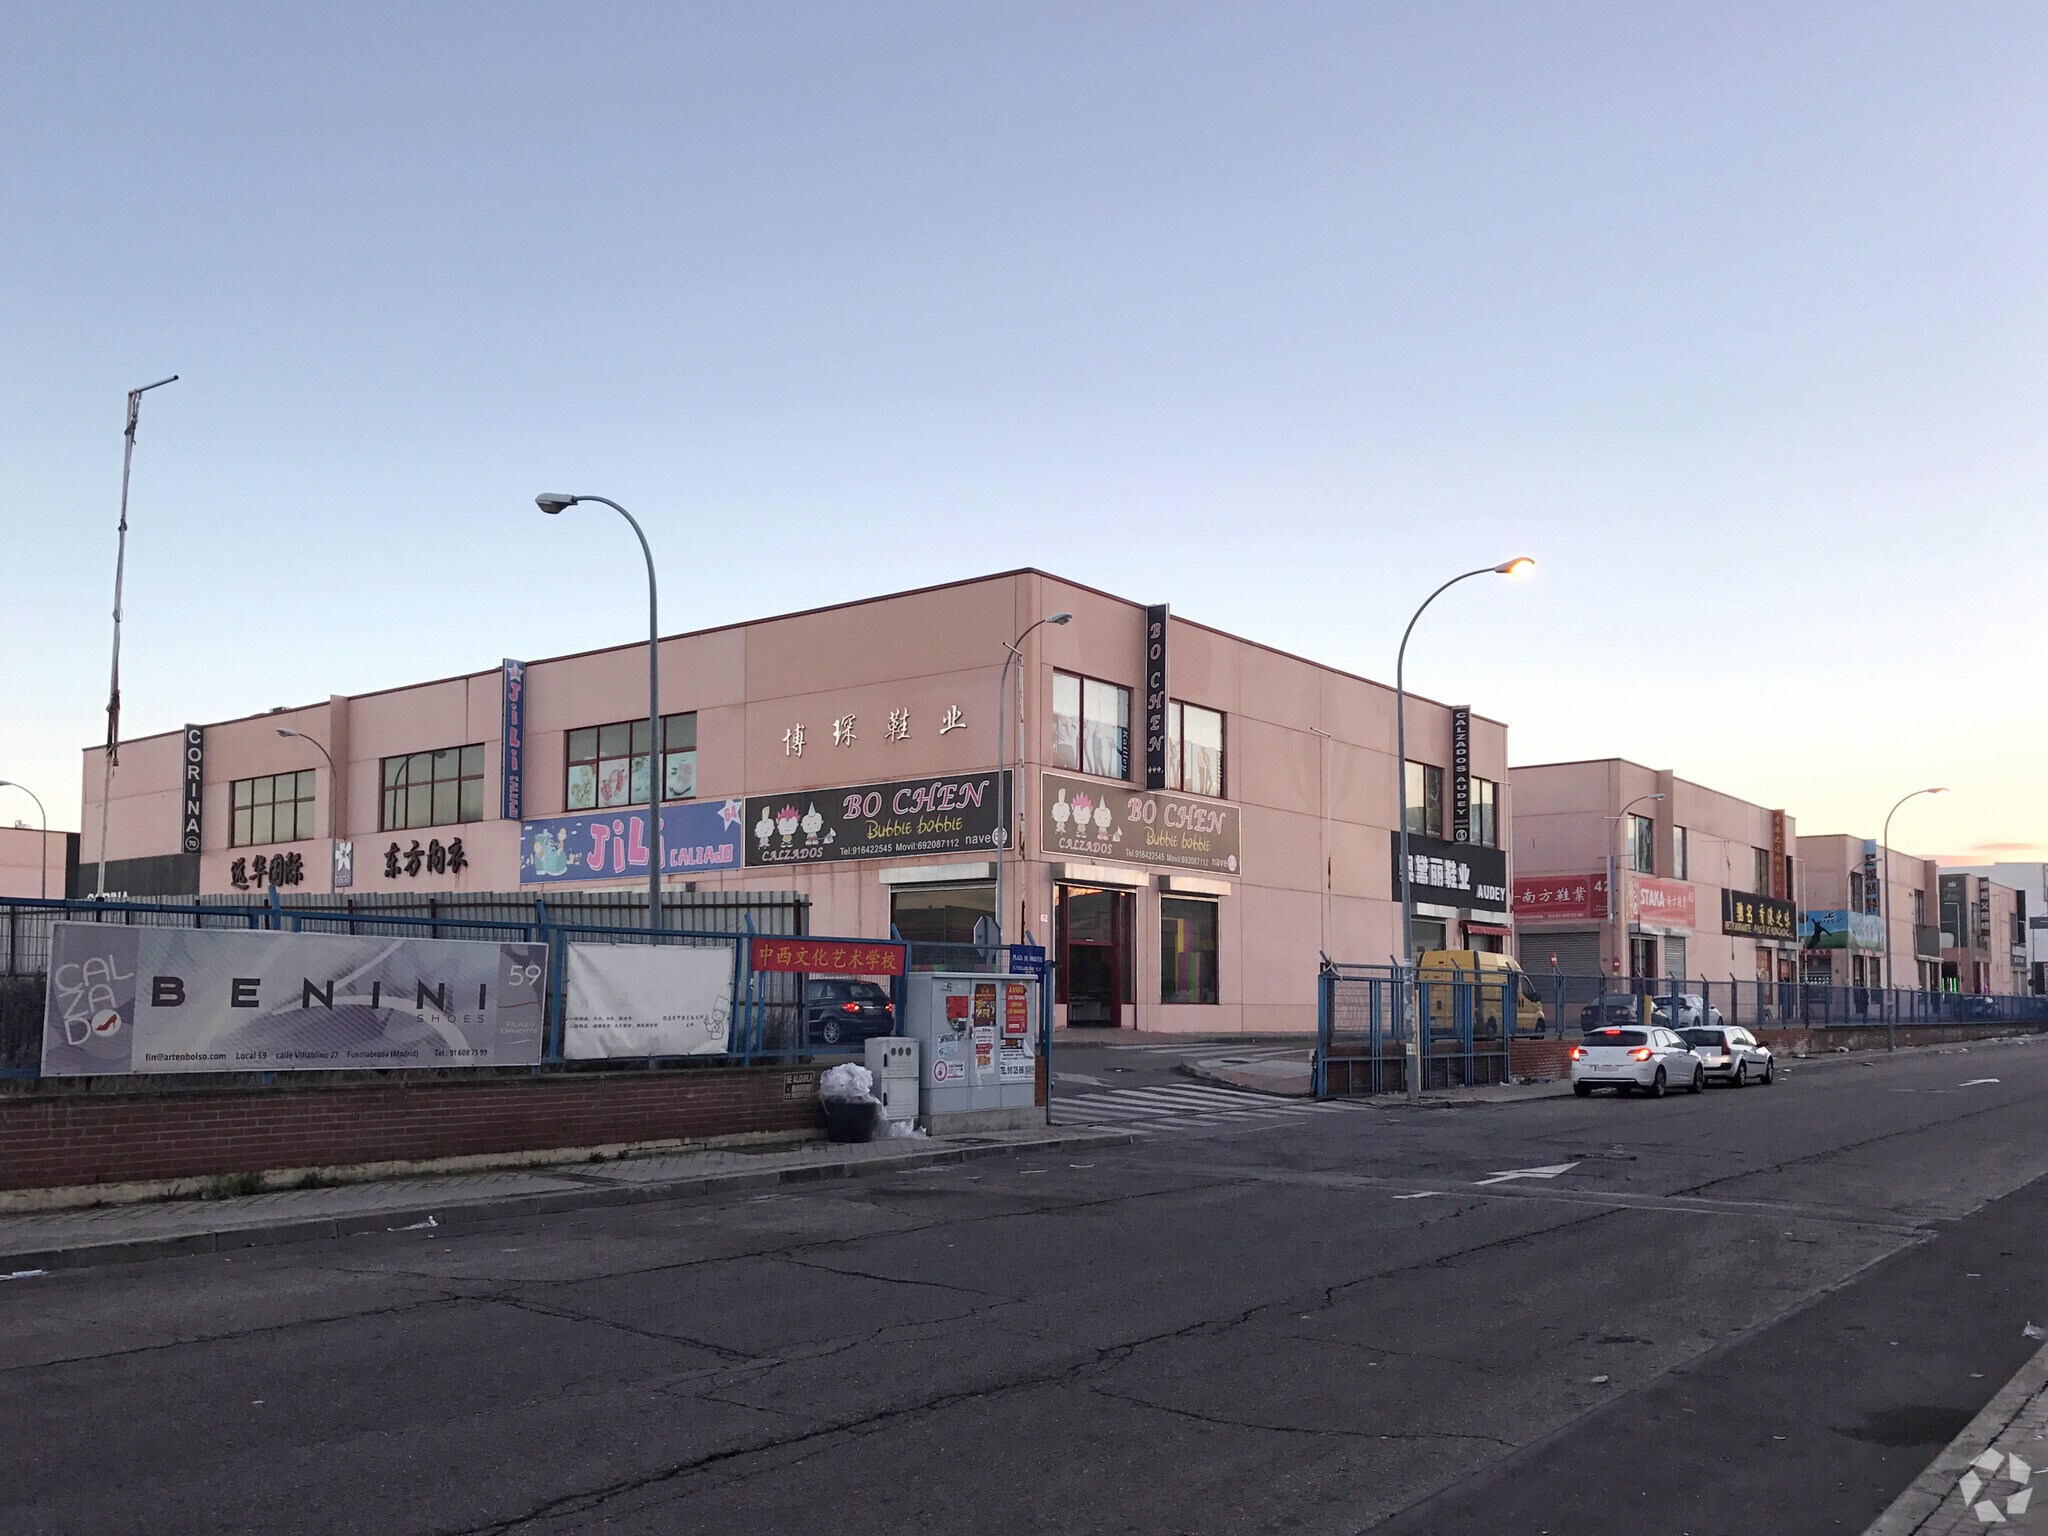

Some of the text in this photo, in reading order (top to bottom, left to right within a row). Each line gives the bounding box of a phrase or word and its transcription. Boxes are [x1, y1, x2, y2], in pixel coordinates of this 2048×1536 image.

[1147, 671, 1164, 753] CHEN
[782, 704, 968, 758] 博琛鞋业
[1455, 712, 1467, 772] CALZADOS
[186, 729, 201, 833] CORINA
[843, 779, 990, 820] BO CHEN
[1456, 776, 1467, 815] AUDEY
[865, 814, 963, 840] Bubble bobble
[1128, 797, 1227, 835] BO CHEN
[965, 833, 991, 846] nave
[1058, 837, 1114, 855] CALZADOS
[1144, 826, 1211, 852] Bubble bobble
[384, 837, 468, 879] 东方内衣
[761, 847, 824, 862] CALZADOS
[1211, 857, 1228, 868] nave
[1476, 884, 1506, 901] AUDEY
[1640, 887, 1665, 907] STAKA
[1041, 914, 1048, 922] 62
[759, 944, 897, 970] 中西文化艺术学校
[55, 954, 134, 992] CAL
[508, 964, 542, 986] 59
[58, 983, 117, 1019] ZA
[151, 976, 487, 1012] BENINI
[416, 1014, 485, 1023] SHOES
[145, 1052, 227, 1061] lin@artenbolso.com
[235, 1051, 256, 1060] Local
[258, 1051, 267, 1059] 59
[276, 1051, 293, 1060] calle
[346, 1050, 389, 1058] Fuenlabrada
[390, 1049, 419, 1058] (Madrid)
